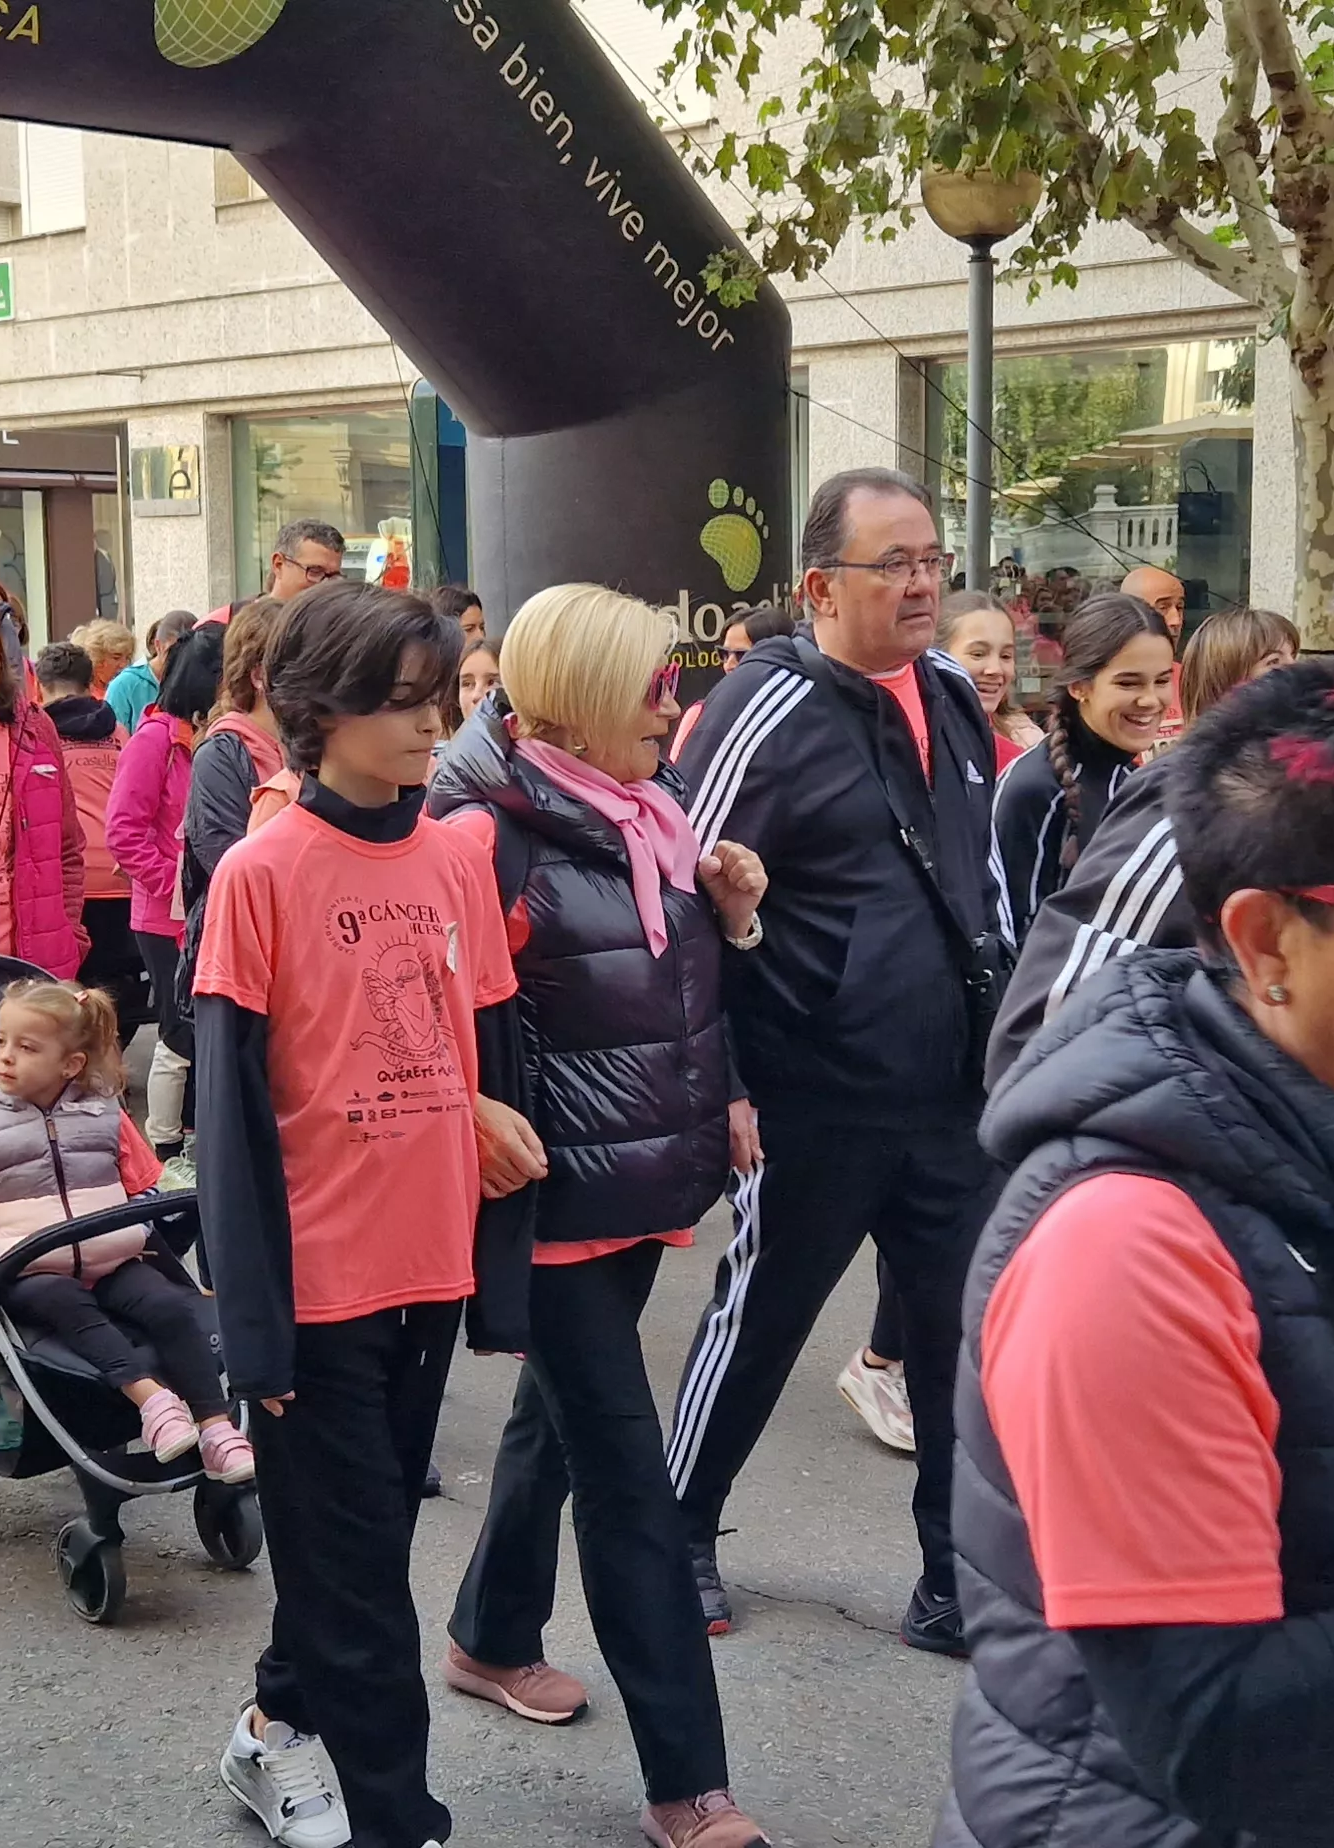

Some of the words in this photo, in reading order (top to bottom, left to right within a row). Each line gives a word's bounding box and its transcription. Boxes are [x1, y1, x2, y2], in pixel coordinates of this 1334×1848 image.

[445, 0, 499, 51] sa
[499, 41, 573, 164] bien,
[584, 155, 645, 242] vive
[643, 239, 735, 352] mejor
[337, 910, 367, 945] 9ª
[368, 898, 442, 924] CÁNCER
[409, 922, 447, 937] HUESC
